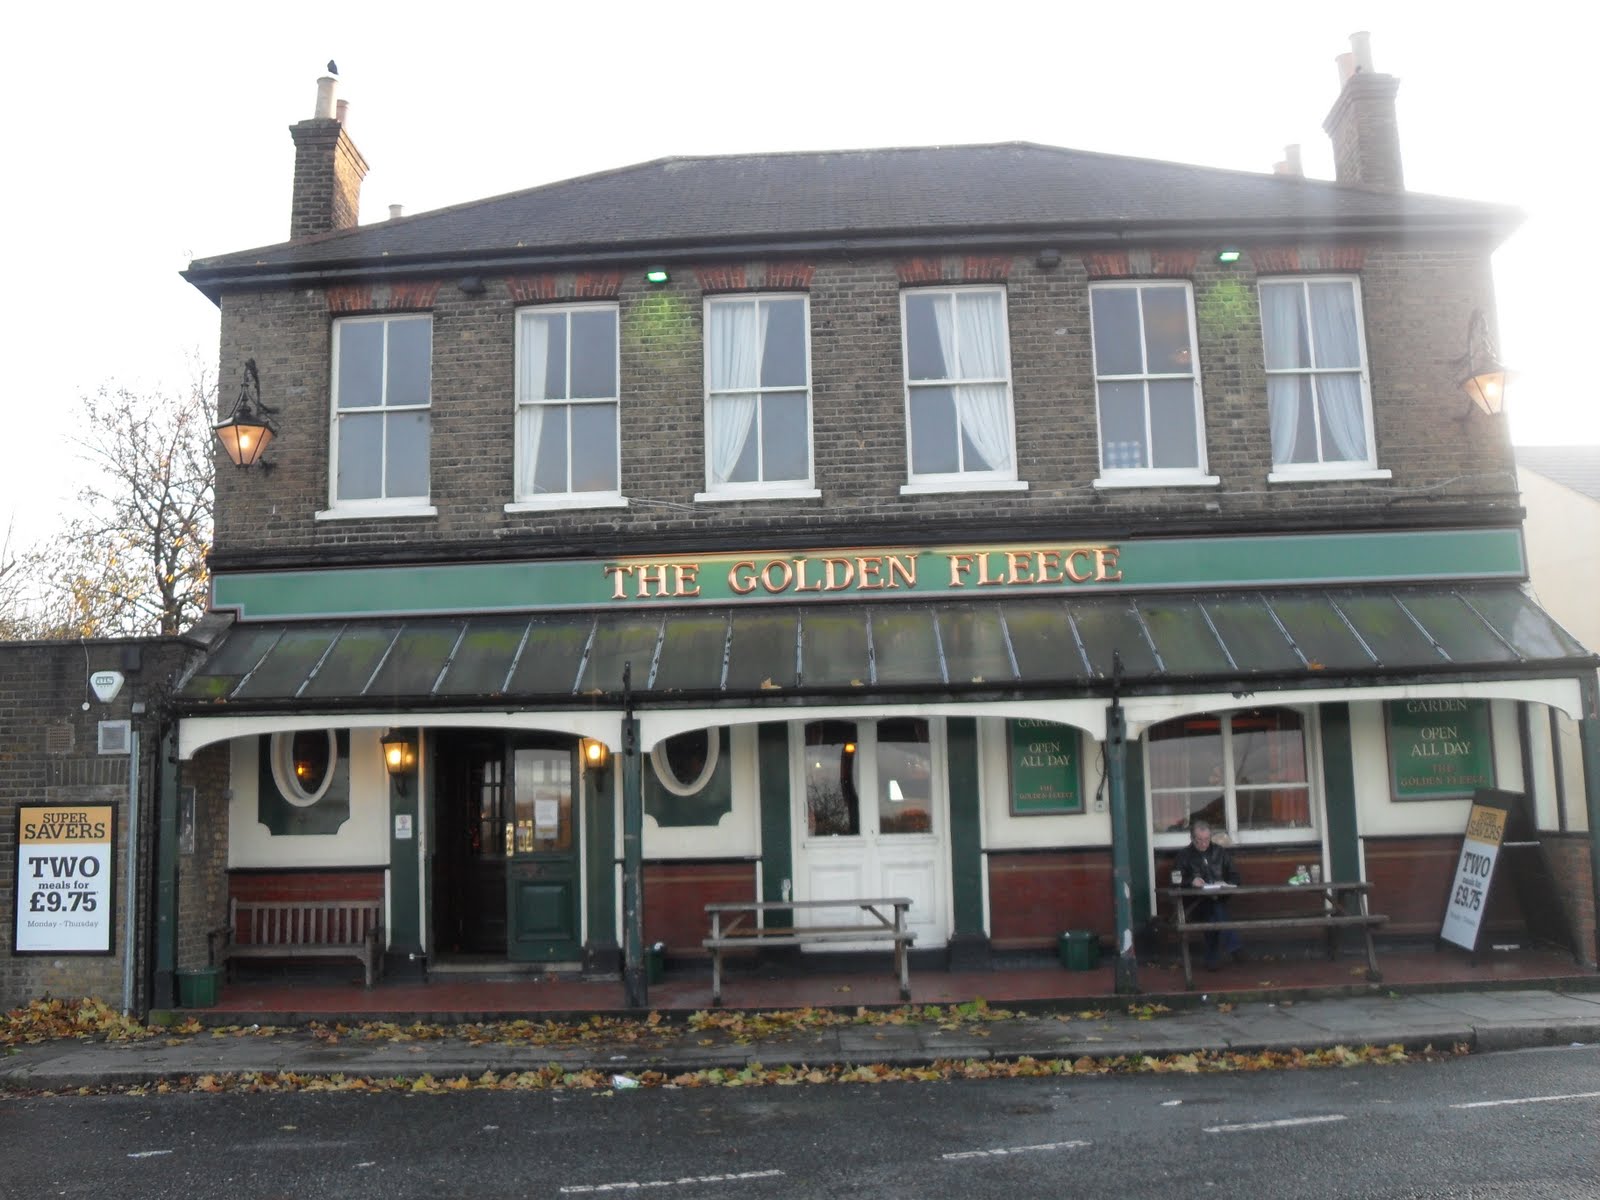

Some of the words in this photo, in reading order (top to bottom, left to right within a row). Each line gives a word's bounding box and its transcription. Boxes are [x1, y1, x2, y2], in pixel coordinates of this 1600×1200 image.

[603, 562, 702, 600] THE
[727, 553, 919, 595] GOLDEN
[946, 546, 1124, 588] FLEECE
[1421, 726, 1458, 740] OPEN
[1029, 742, 1060, 754] OPEN
[1411, 743, 1440, 757] ALL
[1444, 741, 1471, 756] DAY
[1020, 757, 1044, 767] ALL
[1048, 756, 1071, 767] DAY
[1400, 776, 1443, 787] GOLDEN
[42, 812, 87, 824] SUPER
[24, 823, 105, 840] SAVERS
[1468, 820, 1502, 841] SAVERS
[28, 856, 100, 878] TWO
[1462, 851, 1491, 878] TWO
[38, 880, 71, 890] meals
[73, 880, 90, 890] for
[1454, 884, 1483, 912] £9.75
[27, 920, 58, 929] Monday
[64, 920, 99, 929] Thursday
